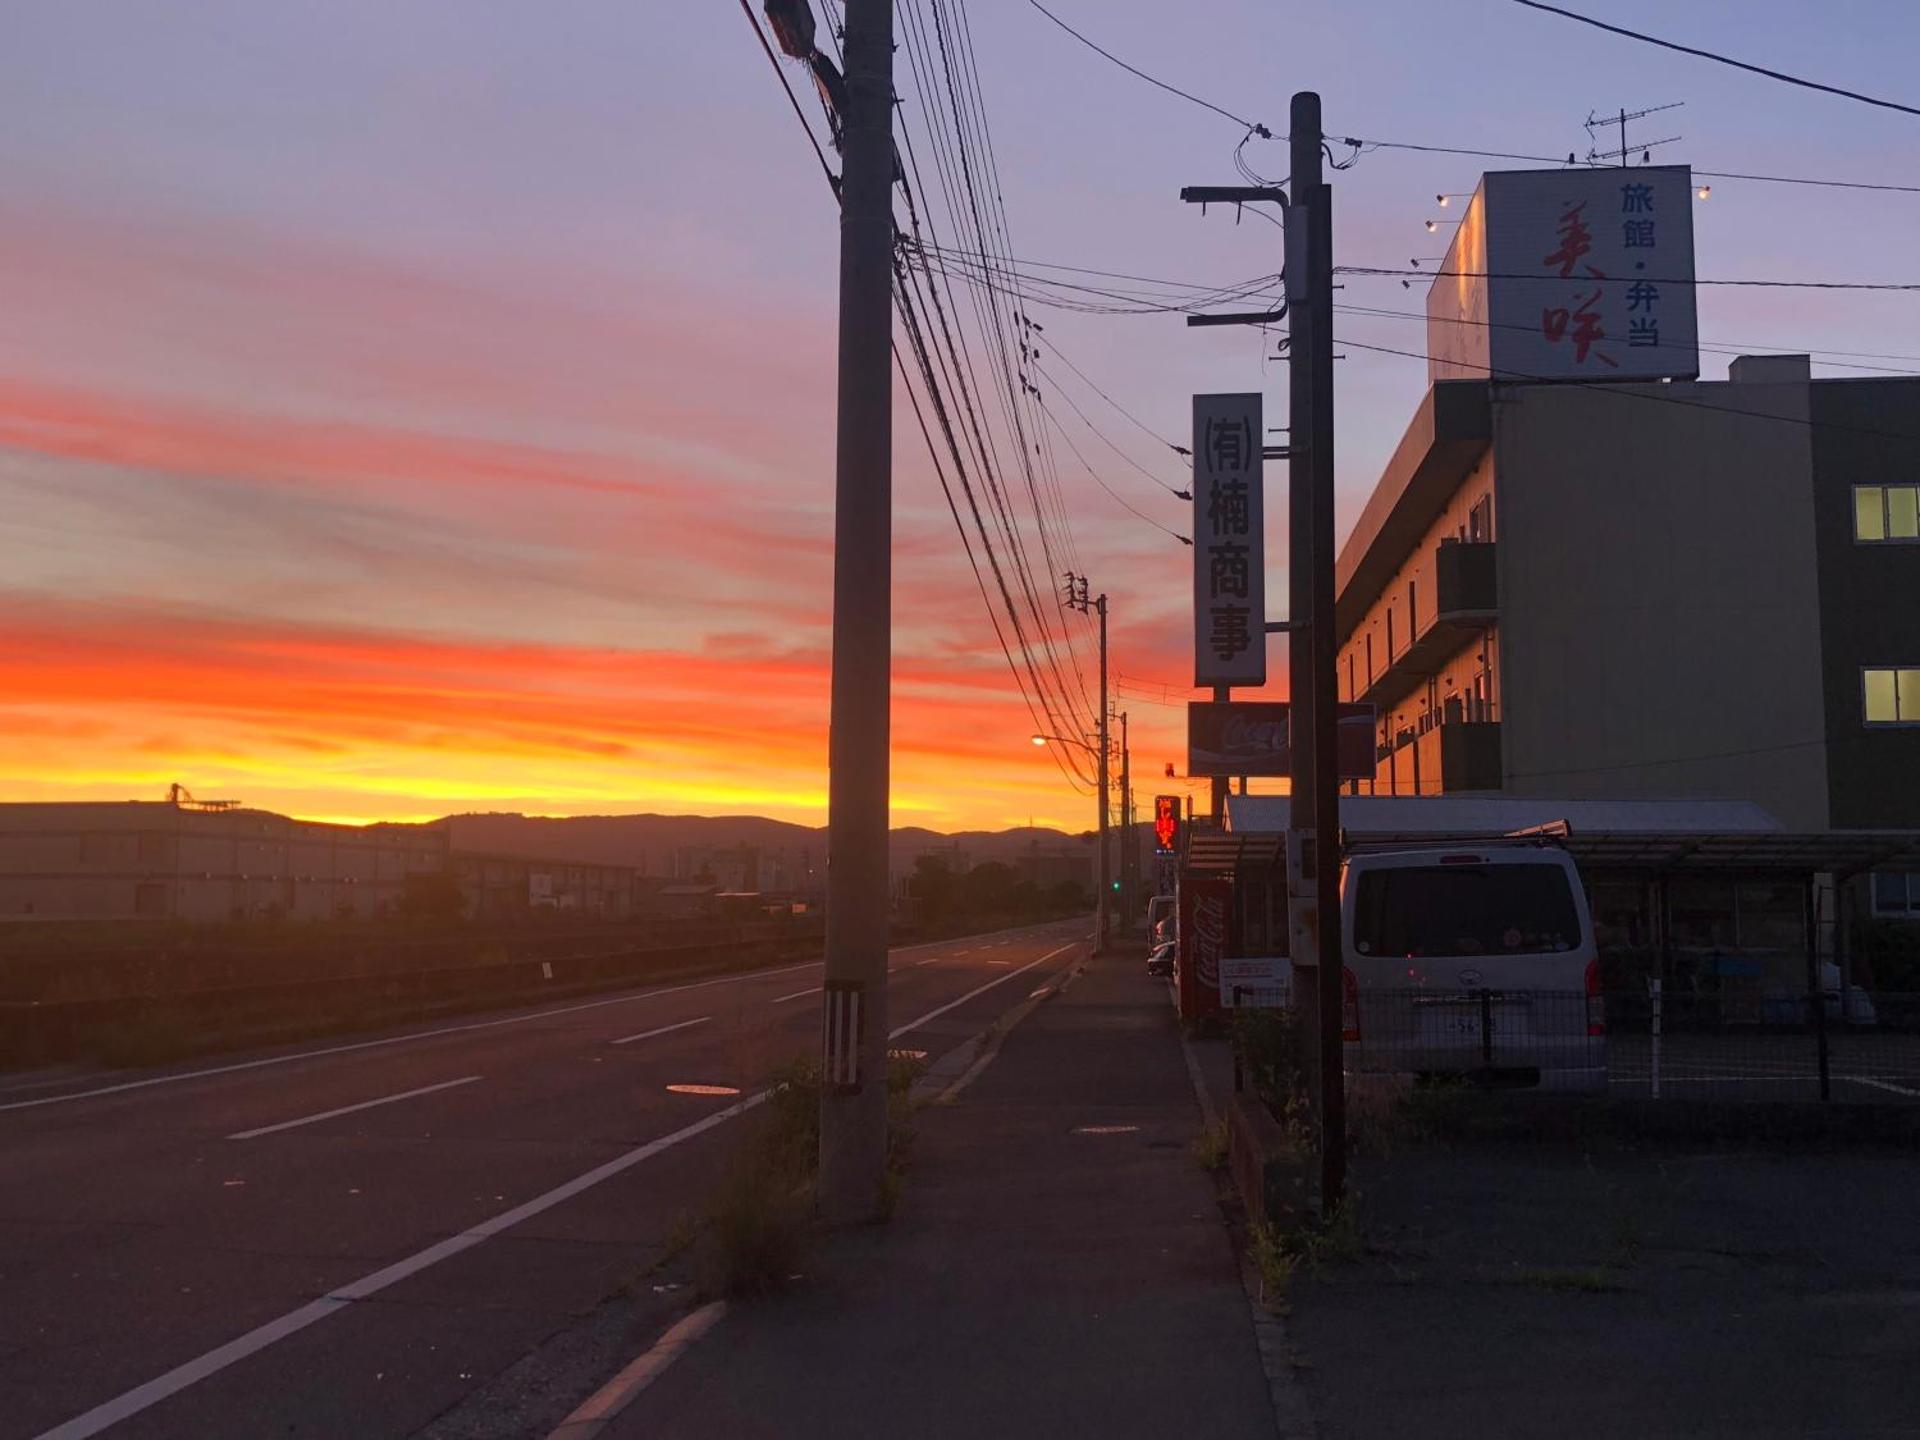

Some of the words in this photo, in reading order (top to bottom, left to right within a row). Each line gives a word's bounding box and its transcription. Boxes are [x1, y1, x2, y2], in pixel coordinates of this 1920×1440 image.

[1543, 199, 1619, 368] 美咲
[1620, 182, 1659, 348] 旅館・弁当
